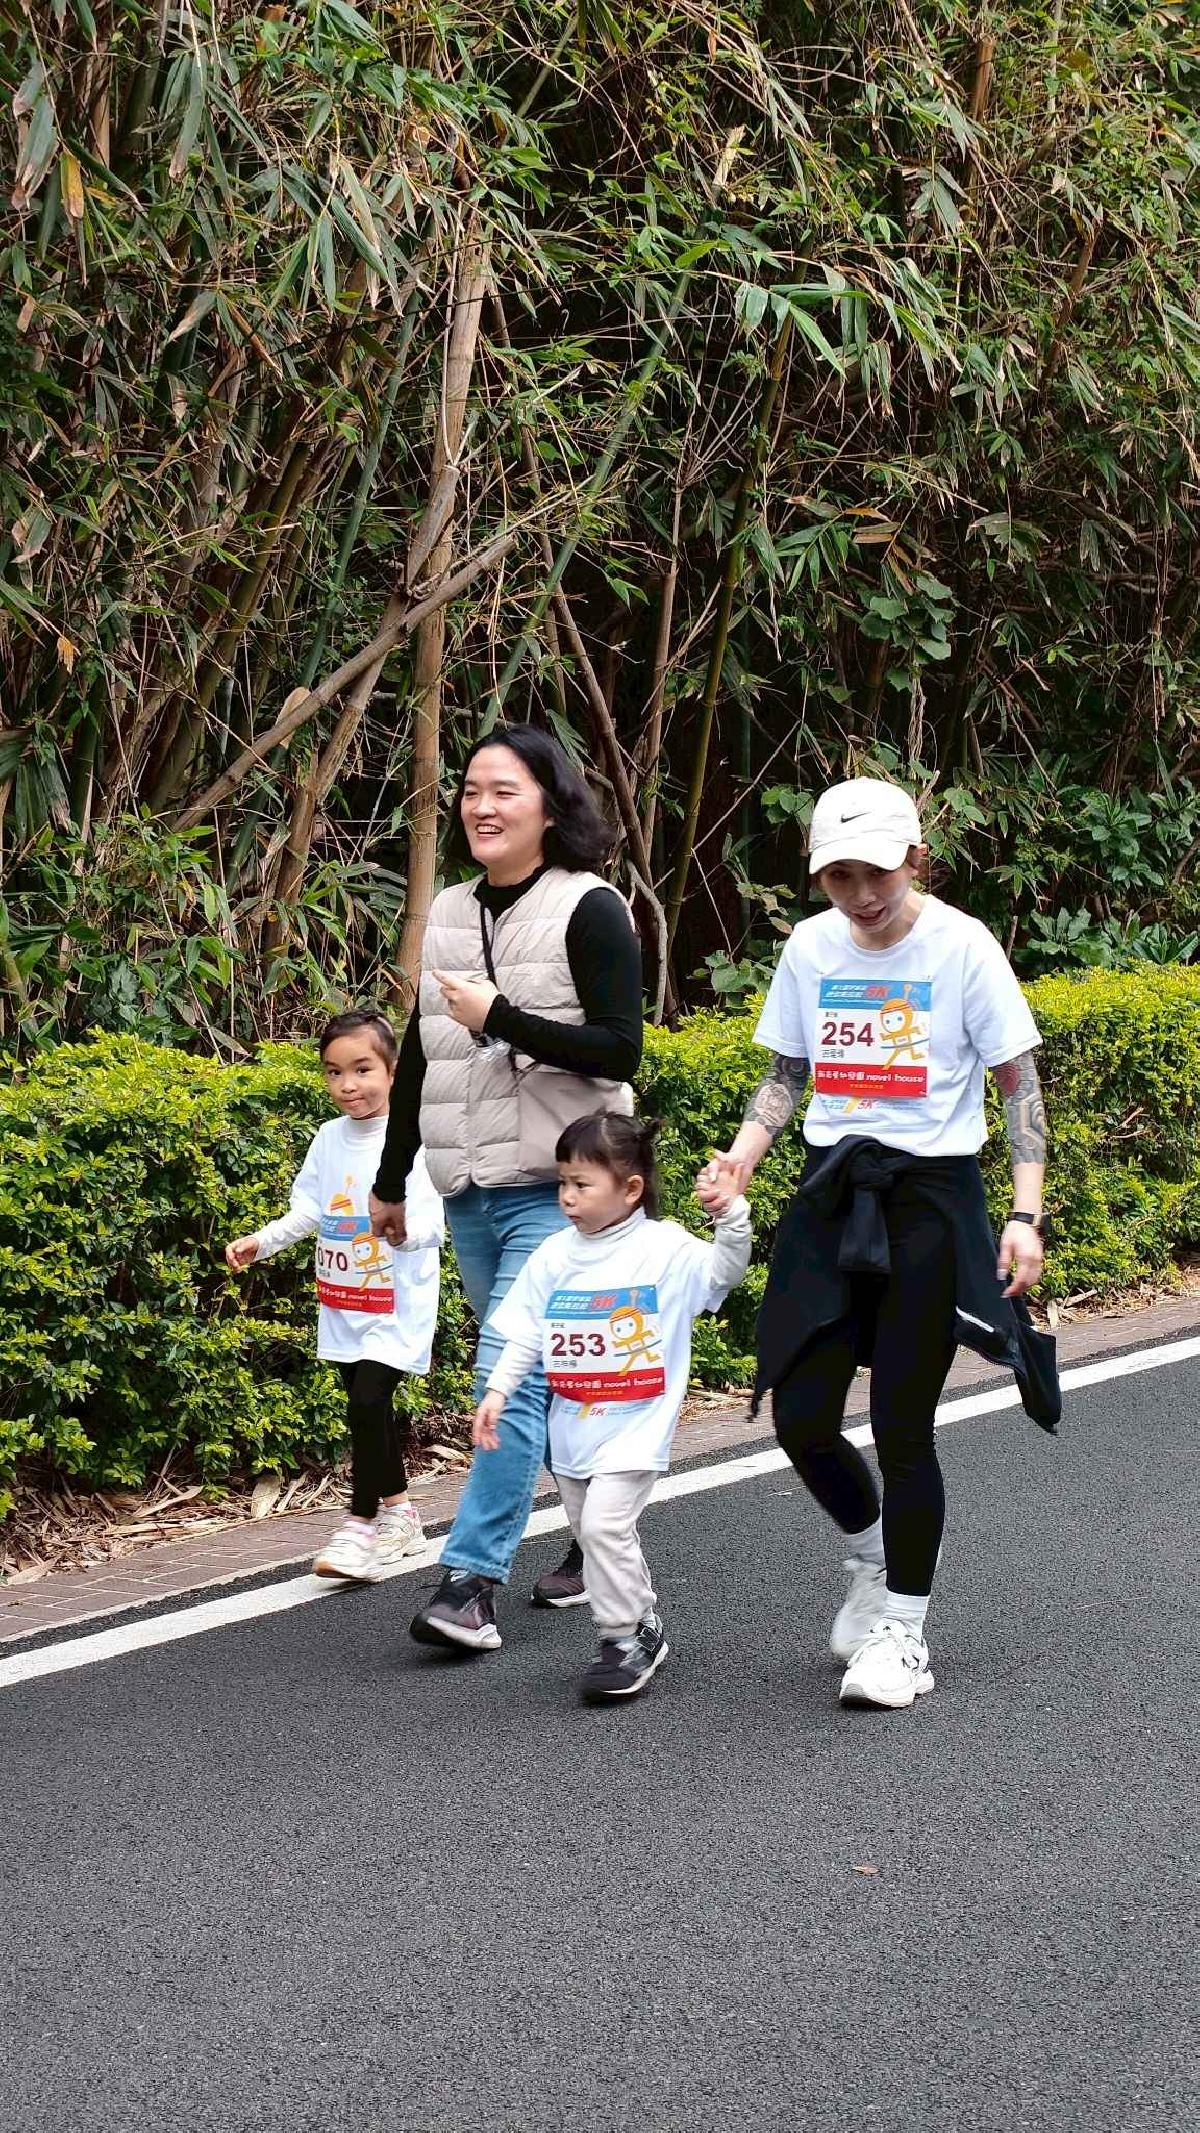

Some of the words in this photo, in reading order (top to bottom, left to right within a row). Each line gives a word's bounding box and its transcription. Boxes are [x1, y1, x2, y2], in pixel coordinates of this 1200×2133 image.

[821, 1021, 875, 1047] 254
[866, 1073, 892, 1082] novel
[894, 1073, 925, 1083] house
[550, 1333, 606, 1357] 253
